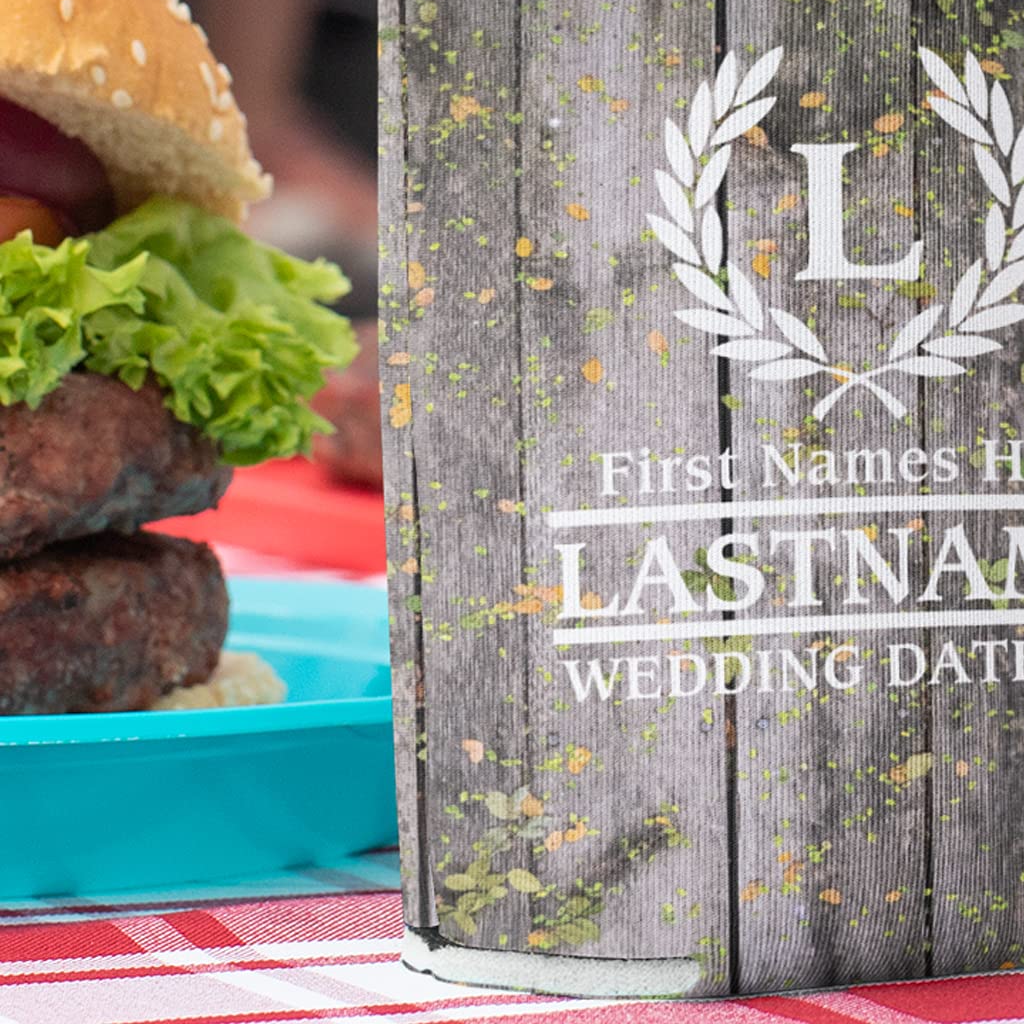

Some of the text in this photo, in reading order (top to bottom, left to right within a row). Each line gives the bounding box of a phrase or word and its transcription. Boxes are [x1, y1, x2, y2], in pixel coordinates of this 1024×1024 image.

[790, 142, 924, 282] L
[599, 446, 739, 496] First
[762, 442, 961, 487] Names
[560, 642, 866, 704] WEDDING
